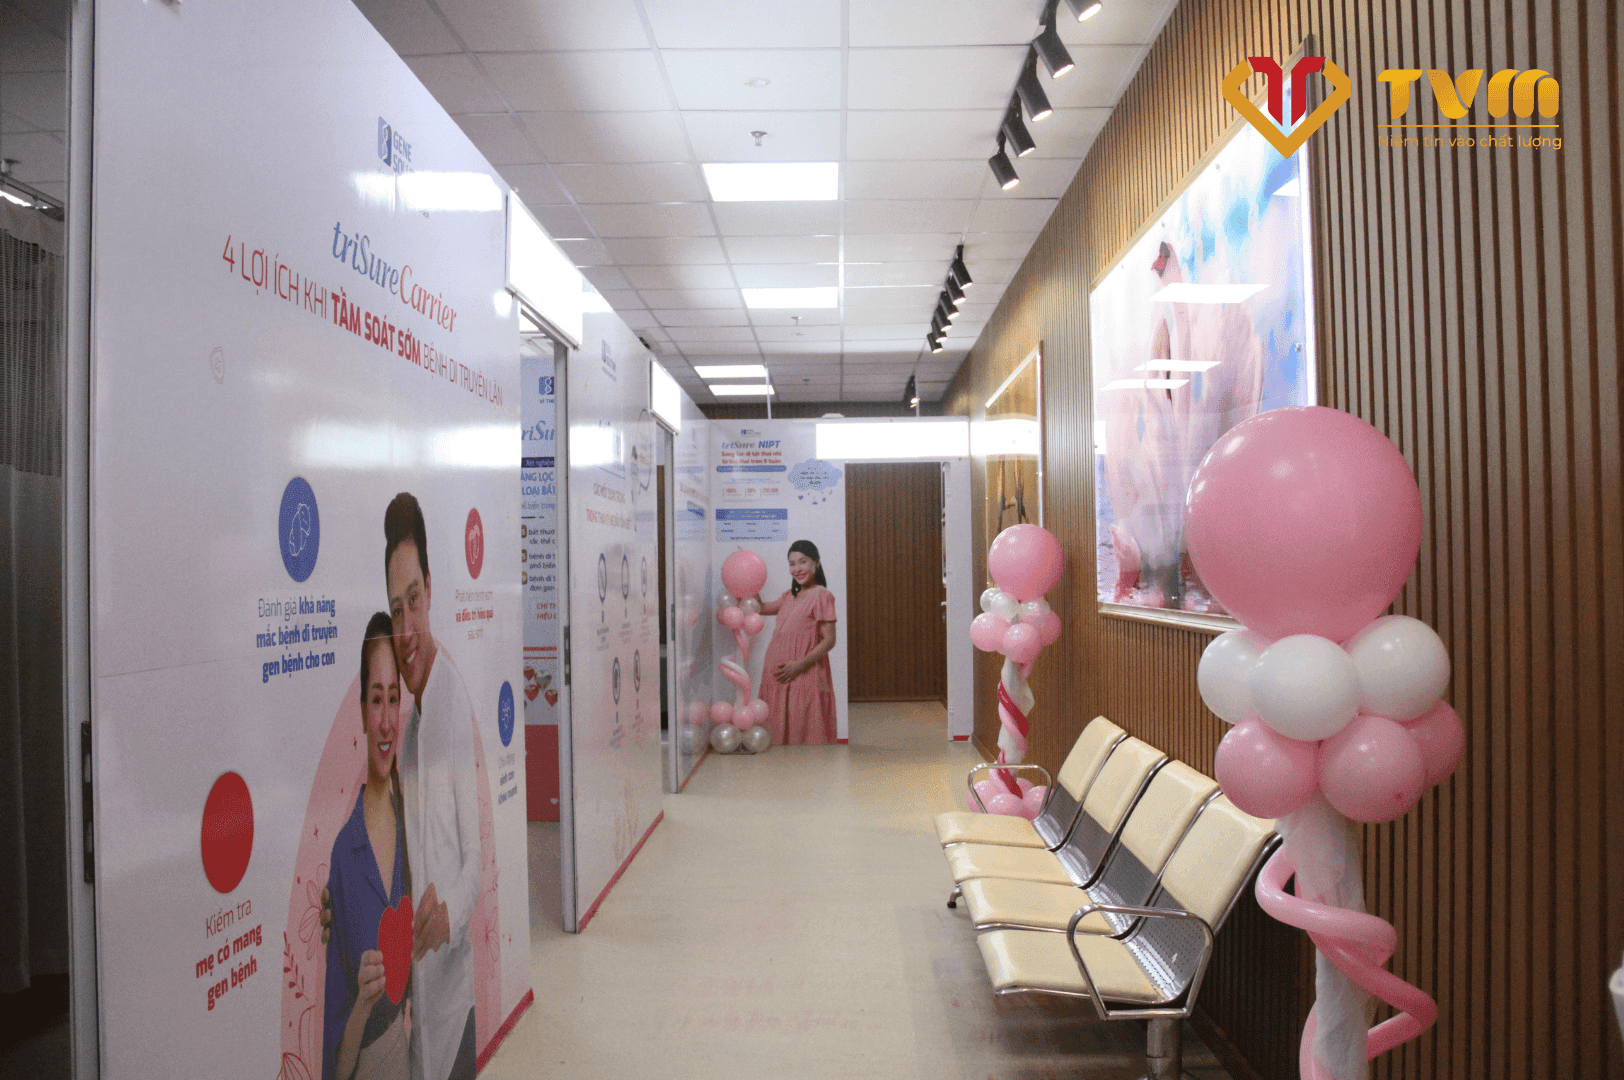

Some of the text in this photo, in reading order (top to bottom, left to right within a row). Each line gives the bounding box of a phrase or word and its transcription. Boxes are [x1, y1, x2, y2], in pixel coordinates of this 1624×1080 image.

[222, 235, 235, 272] 4
[241, 242, 268, 295] LỢI
[274, 253, 299, 305] ÍCH
[304, 277, 327, 319] KHI
[364, 312, 395, 352] SOÁT
[398, 328, 420, 366] SỚM
[423, 342, 447, 379] BỆNH
[449, 358, 457, 384] DI
[758, 440, 781, 449] NIPT
[258, 594, 336, 621] Đánh giá khả năng
[256, 624, 276, 648] mắc
[279, 625, 300, 650] bệnh
[311, 620, 338, 645] truyền
[262, 651, 335, 683] gen bệnh cho con
[206, 900, 252, 939] Kiểm tra
[195, 923, 262, 978] mẹ có mang
[207, 954, 257, 1011] gen bệnh
